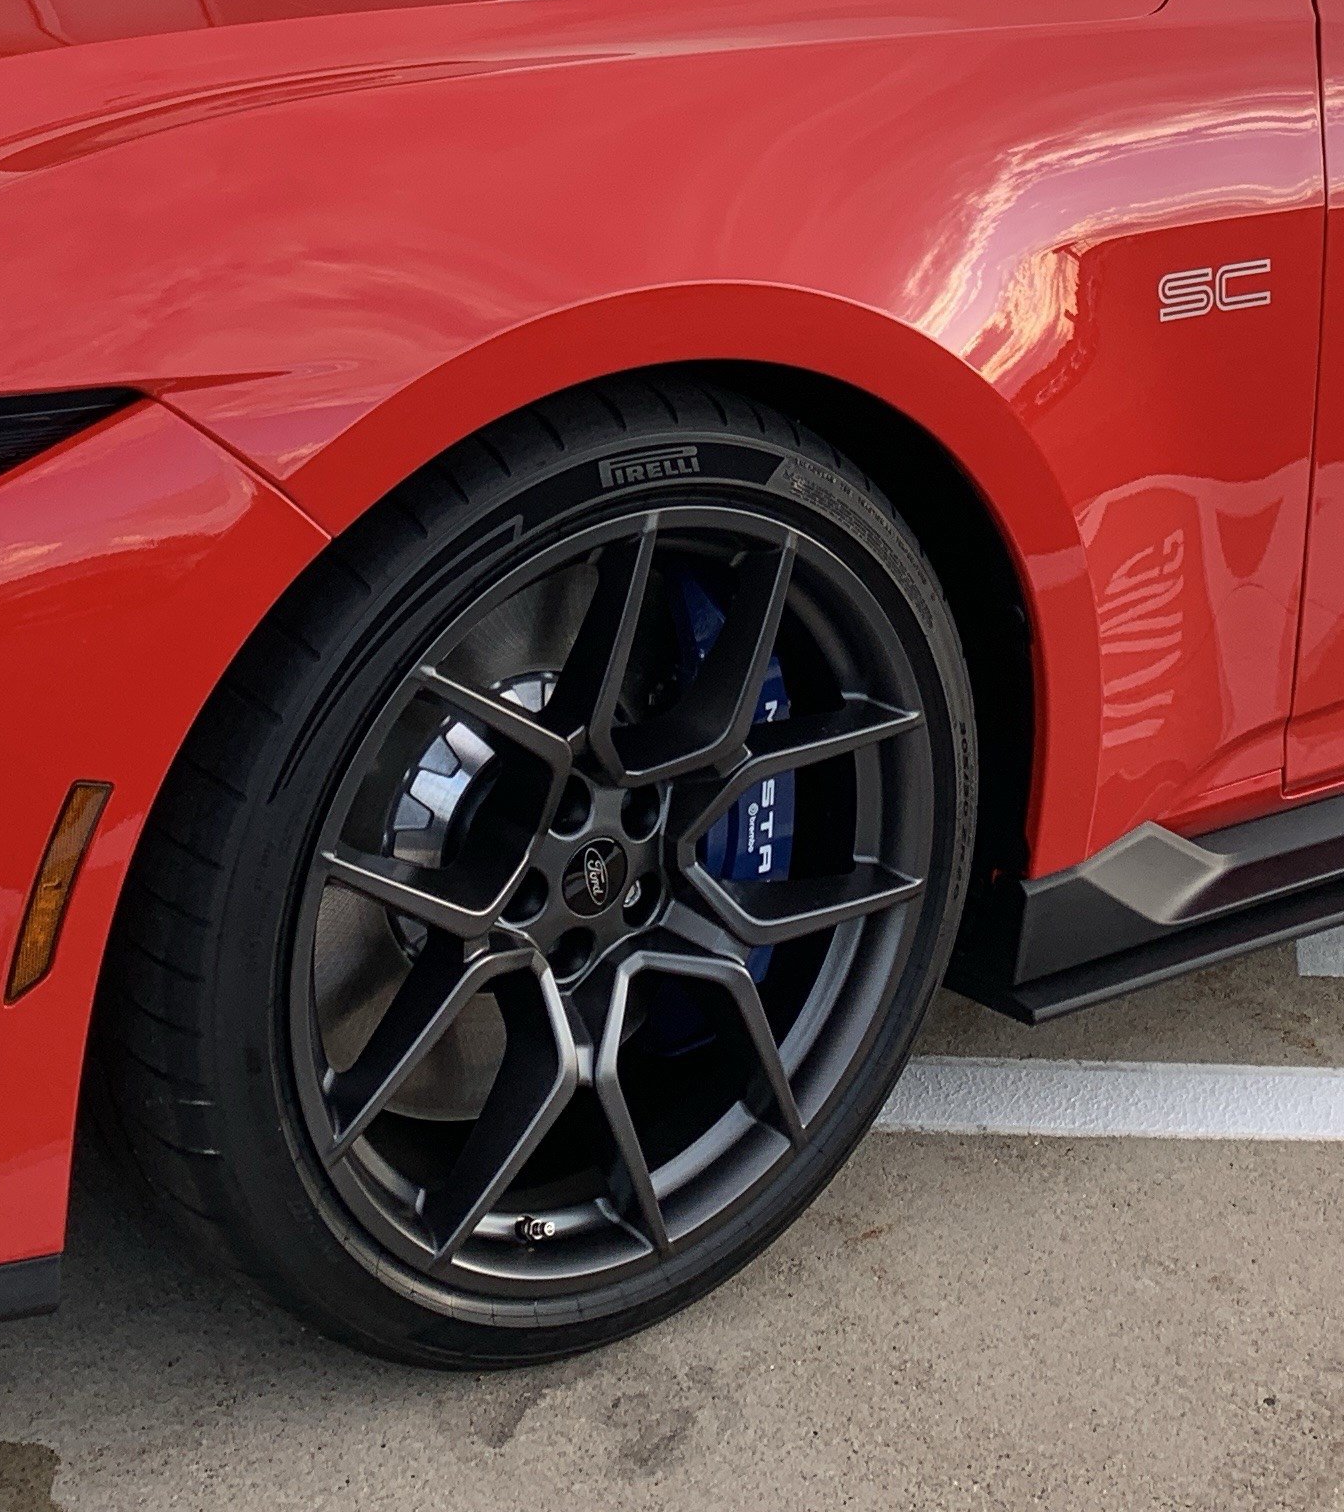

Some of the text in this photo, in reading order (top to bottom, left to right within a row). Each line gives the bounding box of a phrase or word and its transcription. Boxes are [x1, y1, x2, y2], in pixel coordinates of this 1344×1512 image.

[1158, 258, 1271, 322] SC
[598, 445, 700, 488] PIRELLI
[748, 816, 757, 854] brembo
[587, 859, 605, 896] Ford
